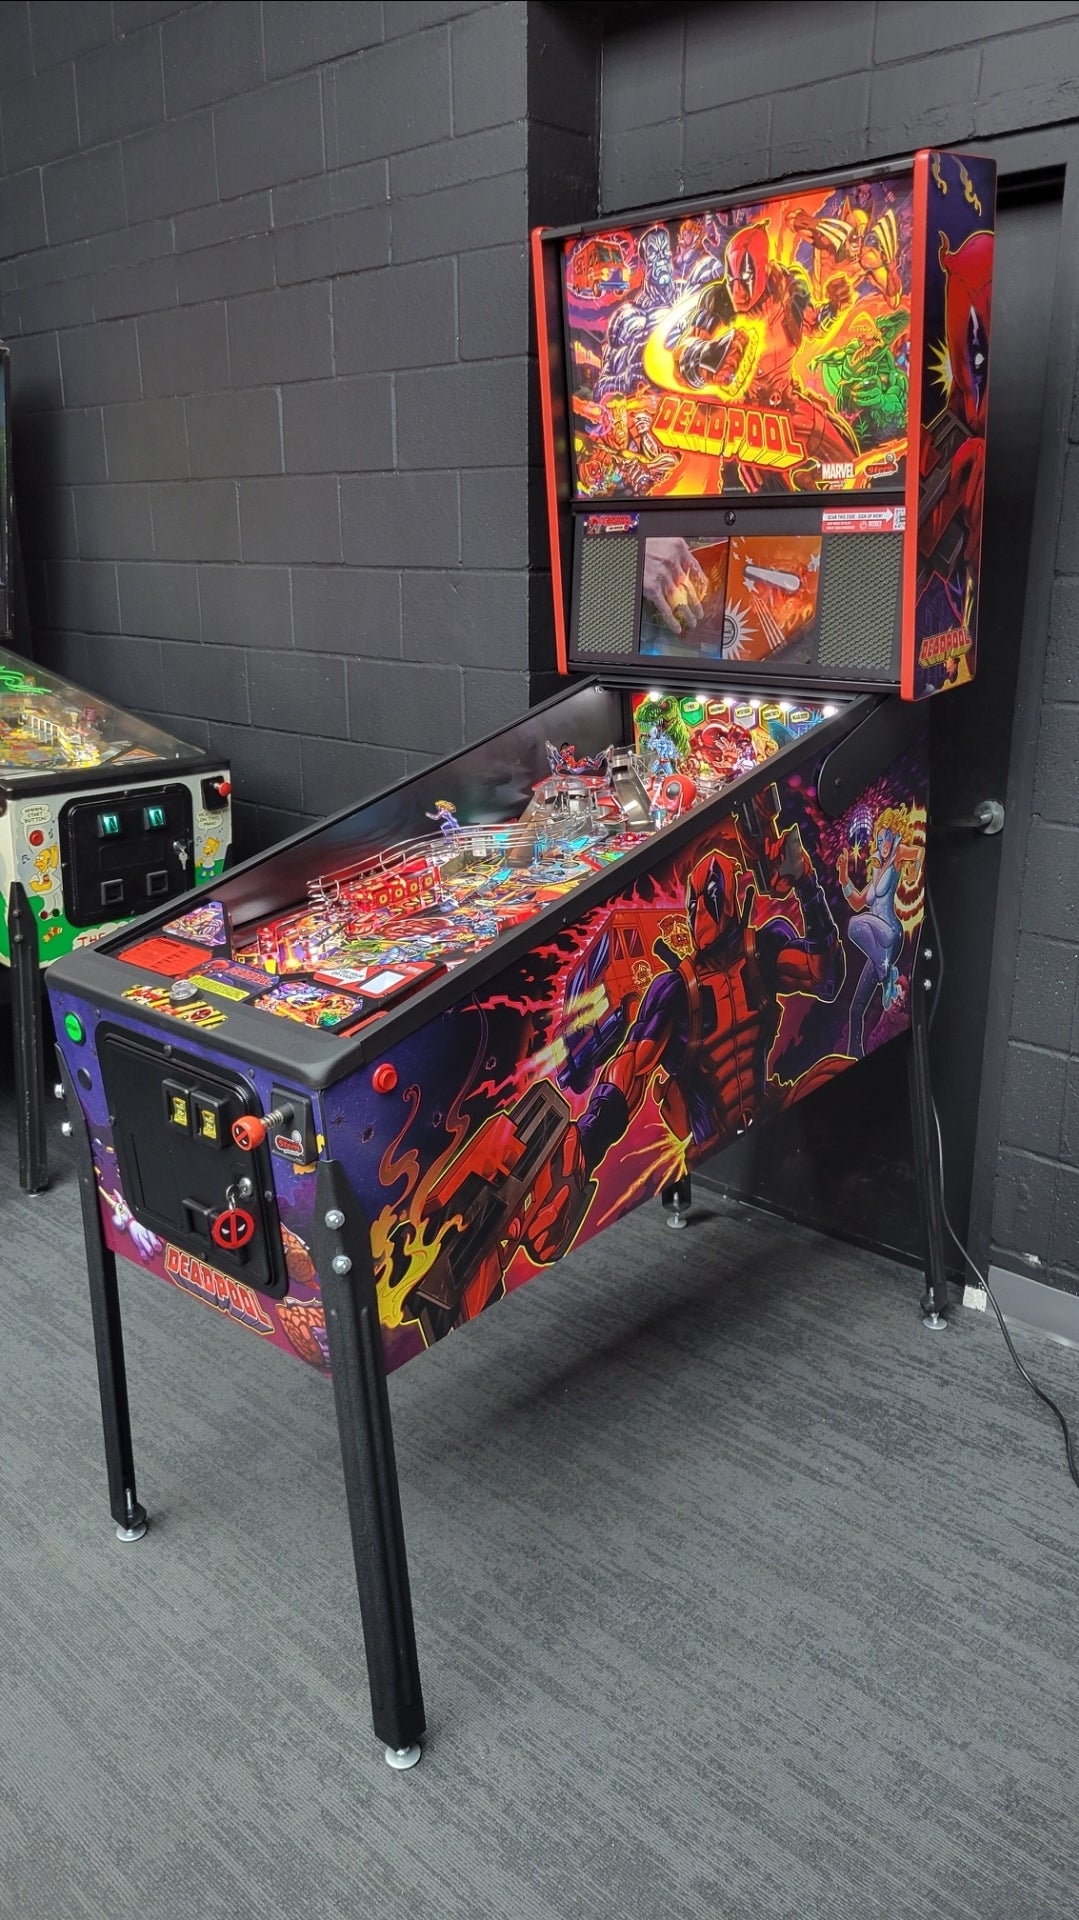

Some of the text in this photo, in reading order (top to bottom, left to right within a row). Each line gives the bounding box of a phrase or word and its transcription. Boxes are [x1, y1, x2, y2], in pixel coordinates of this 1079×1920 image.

[651, 397, 804, 464] DEADPOOL
[822, 463, 854, 480] MARVEL
[919, 628, 972, 667] DEADPOOL
[277, 1139, 301, 1152] Stern
[166, 1246, 274, 1332] DEADPOOL
